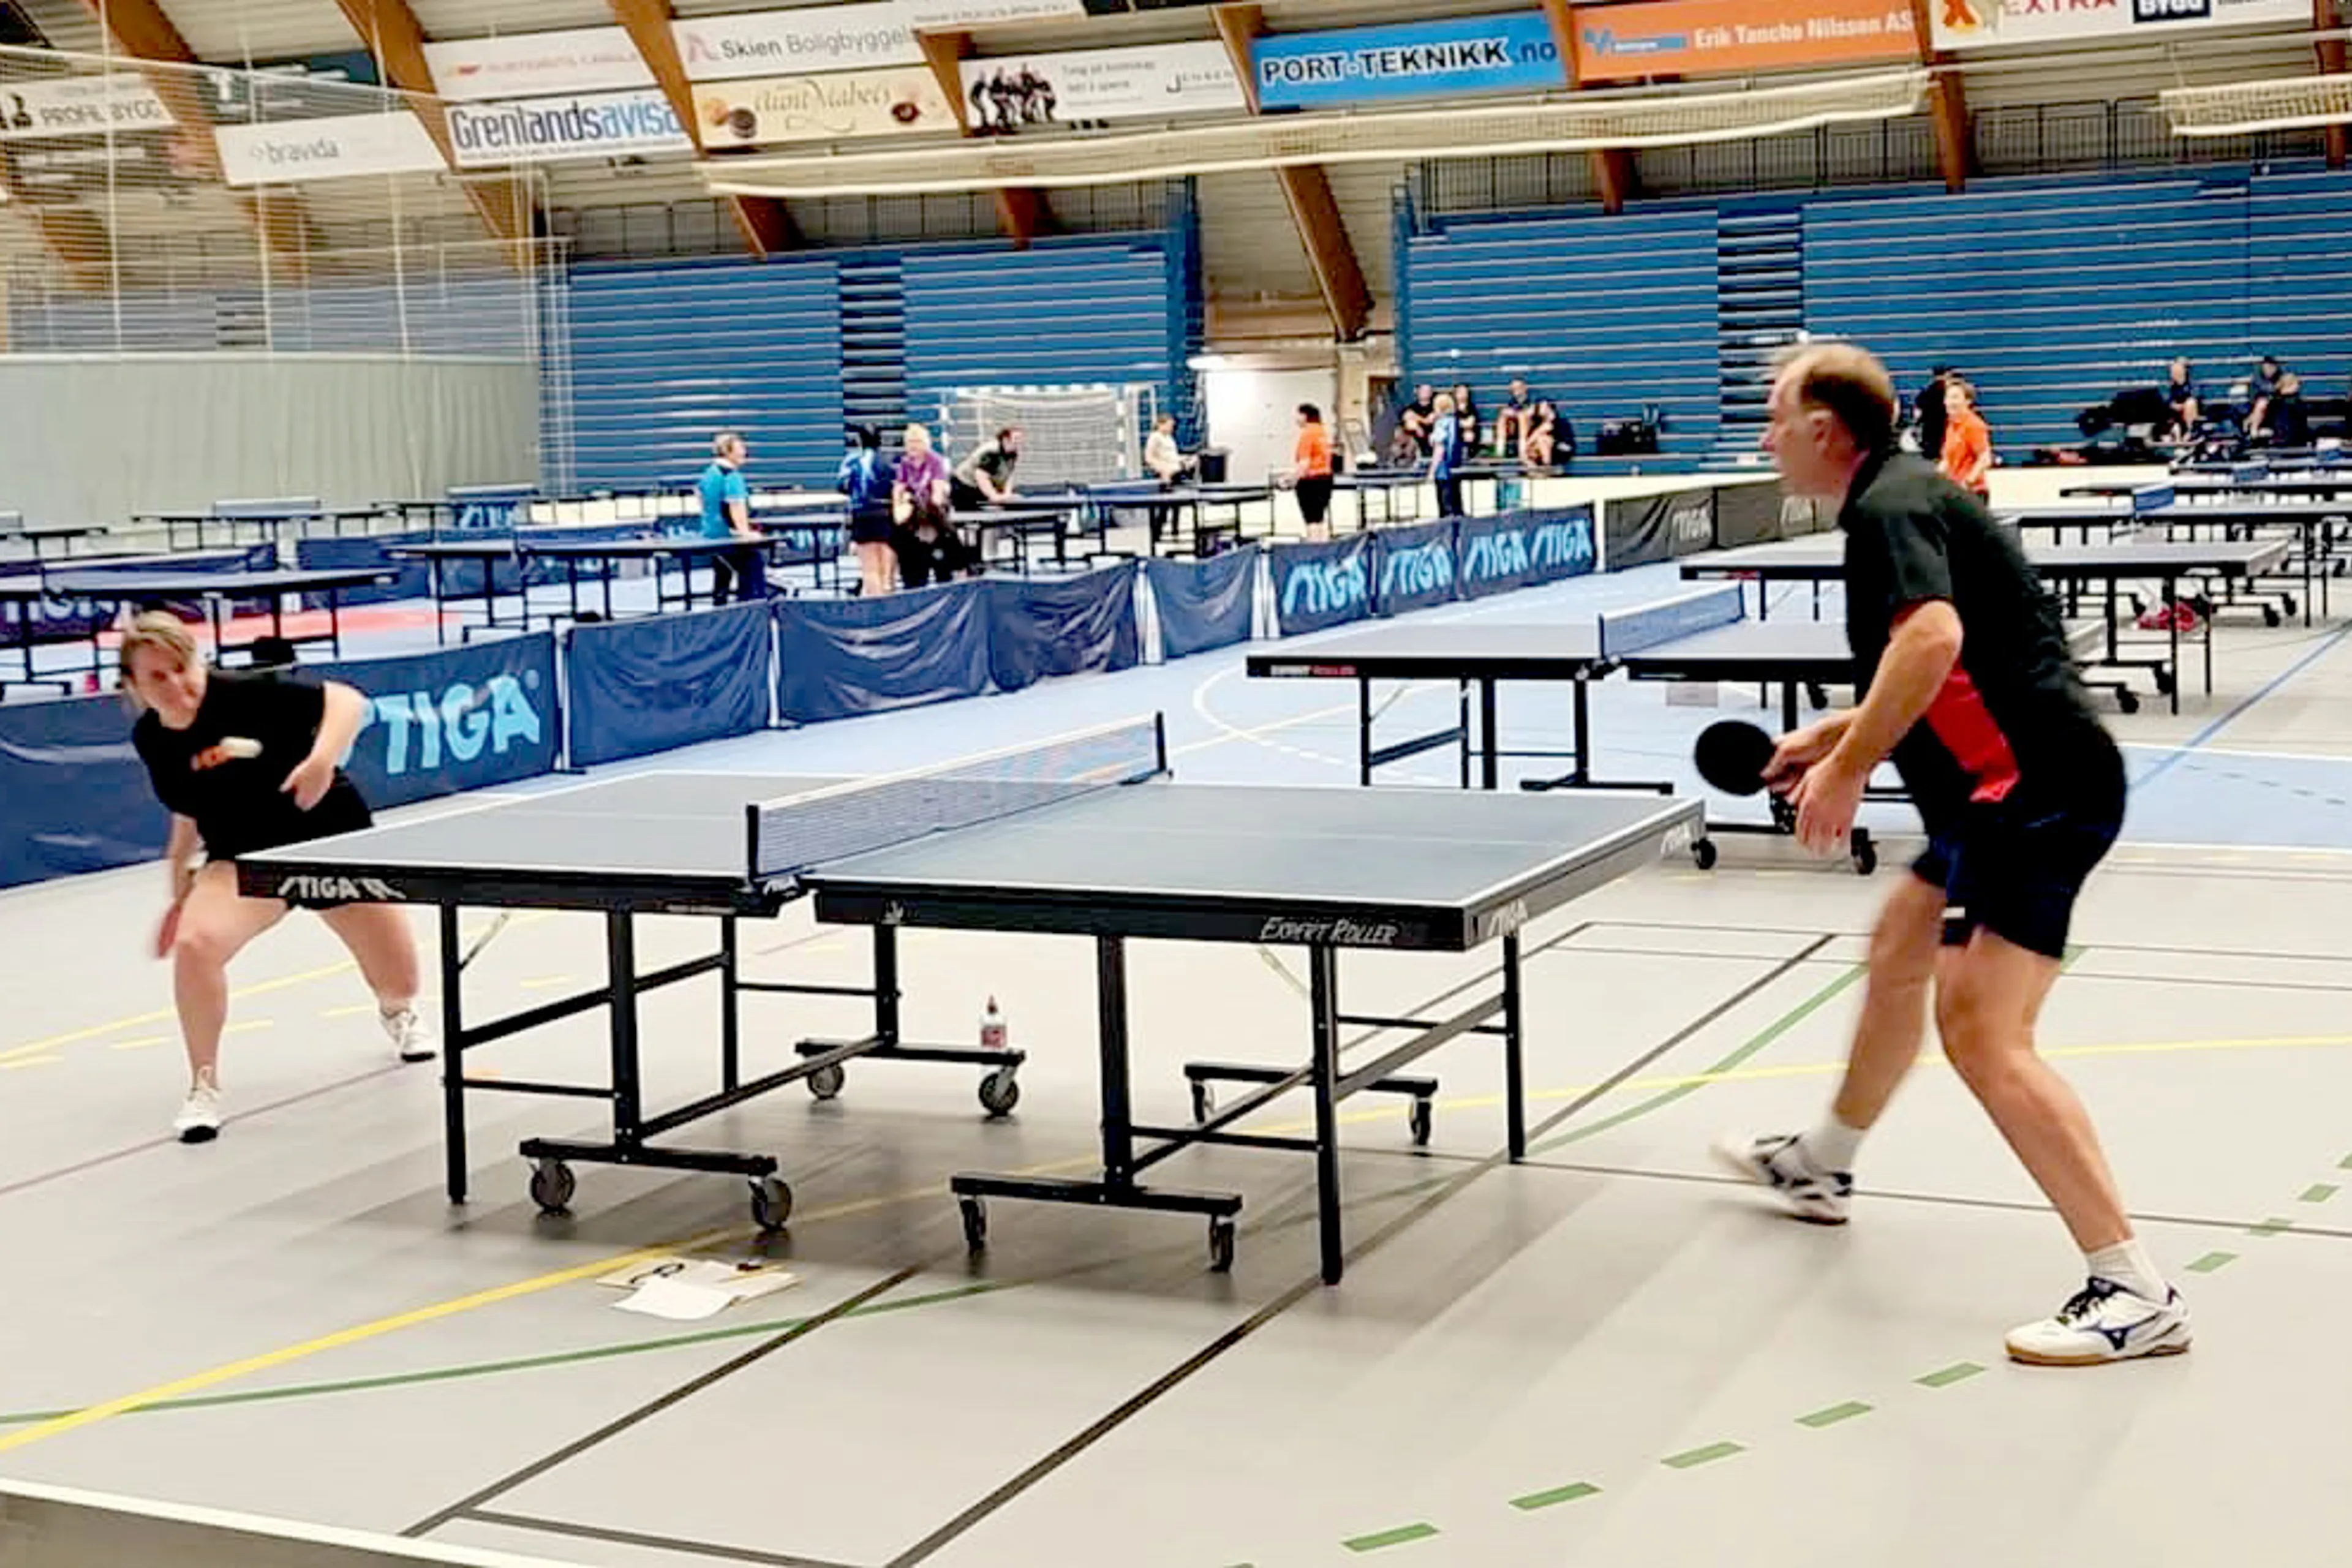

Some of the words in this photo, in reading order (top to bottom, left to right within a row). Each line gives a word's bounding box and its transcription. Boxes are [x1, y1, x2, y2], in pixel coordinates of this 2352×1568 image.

[720, 38, 782, 59] Skien
[1694, 26, 1731, 48] Erik
[1885, 10, 1914, 33] AS
[1464, 529, 1529, 581] STIGA
[1531, 519, 1592, 565] STIGA
[1283, 554, 1367, 615] STIGA
[1379, 545, 1453, 595] STIGA
[277, 875, 361, 899] STIGA
[1259, 916, 1333, 942] EXPERT
